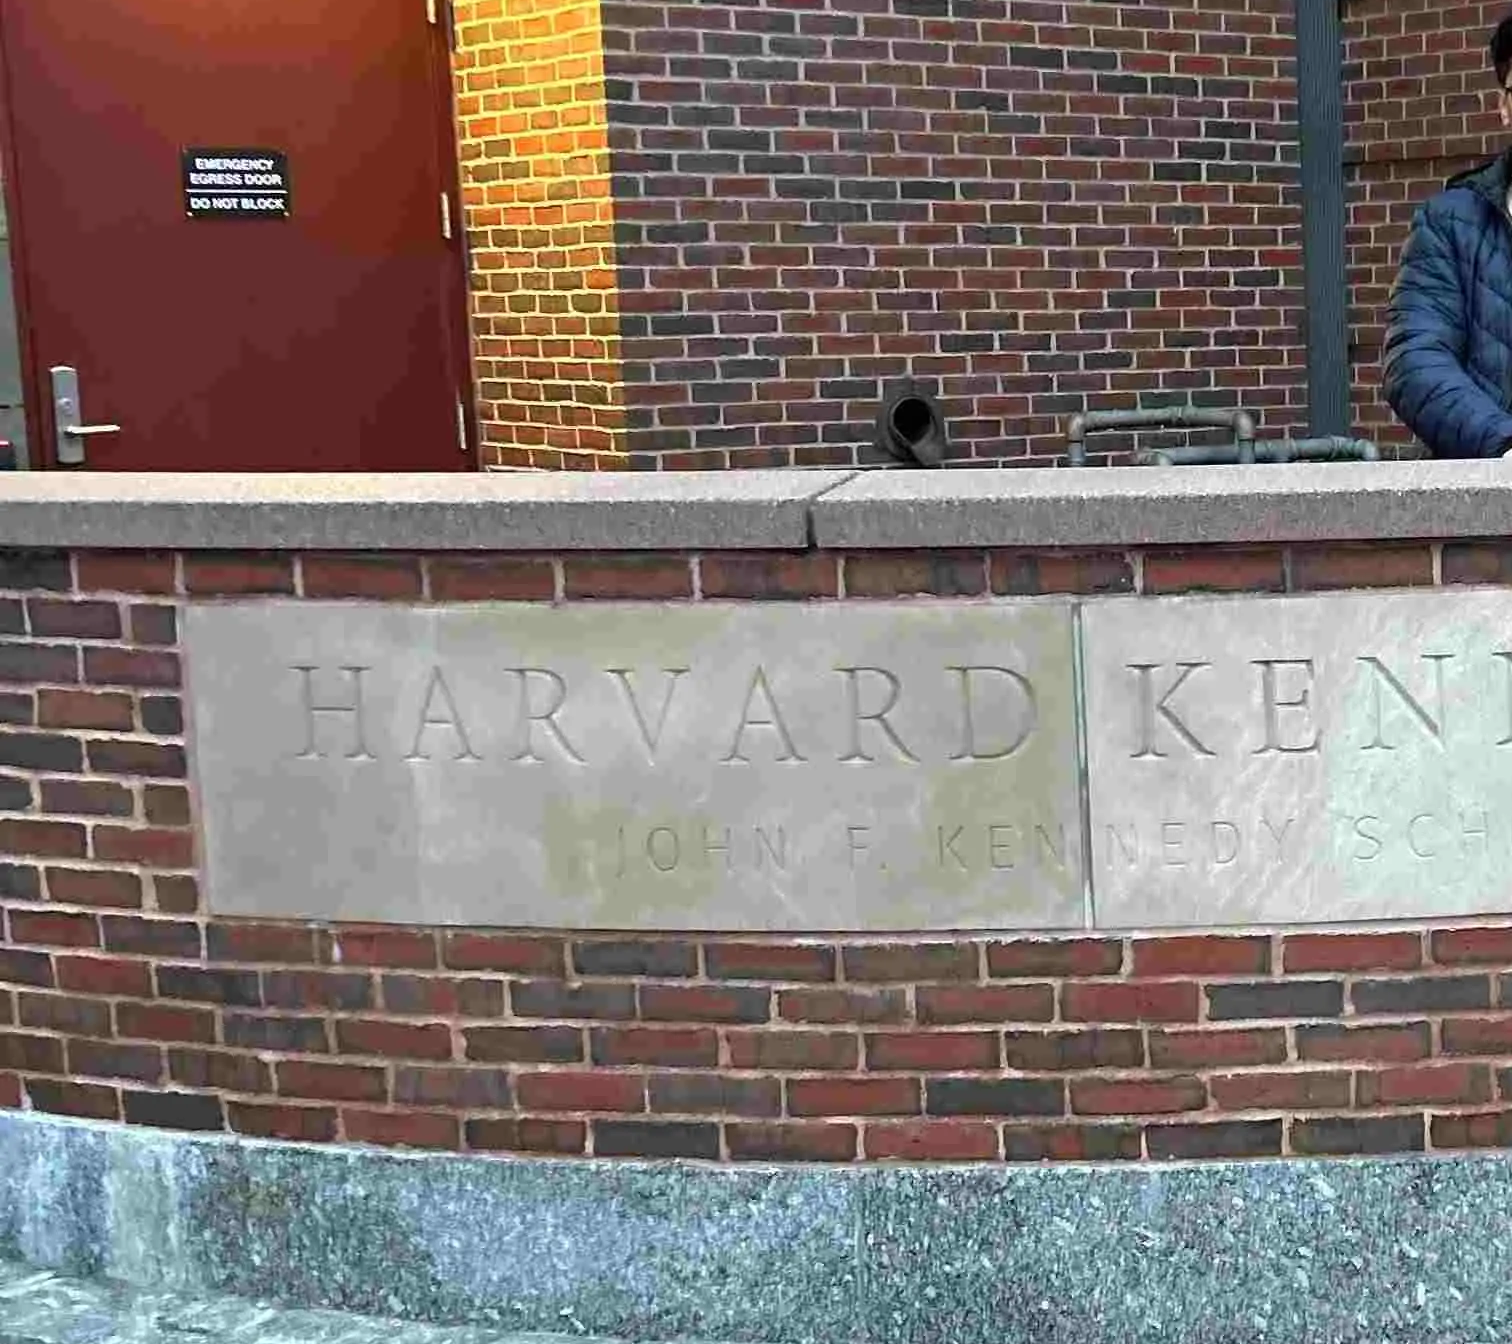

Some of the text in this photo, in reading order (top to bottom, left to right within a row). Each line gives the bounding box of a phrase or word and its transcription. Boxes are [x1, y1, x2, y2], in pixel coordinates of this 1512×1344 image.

[195, 158, 274, 170] EMERGENCY
[189, 172, 282, 186] EGRESS DOOR
[190, 198, 285, 210] DO NOT BLOCK
[288, 664, 1040, 765] HARVARD
[613, 824, 790, 878] JOHN
[844, 824, 890, 872] F.
[935, 816, 1298, 874] KENNEDY
